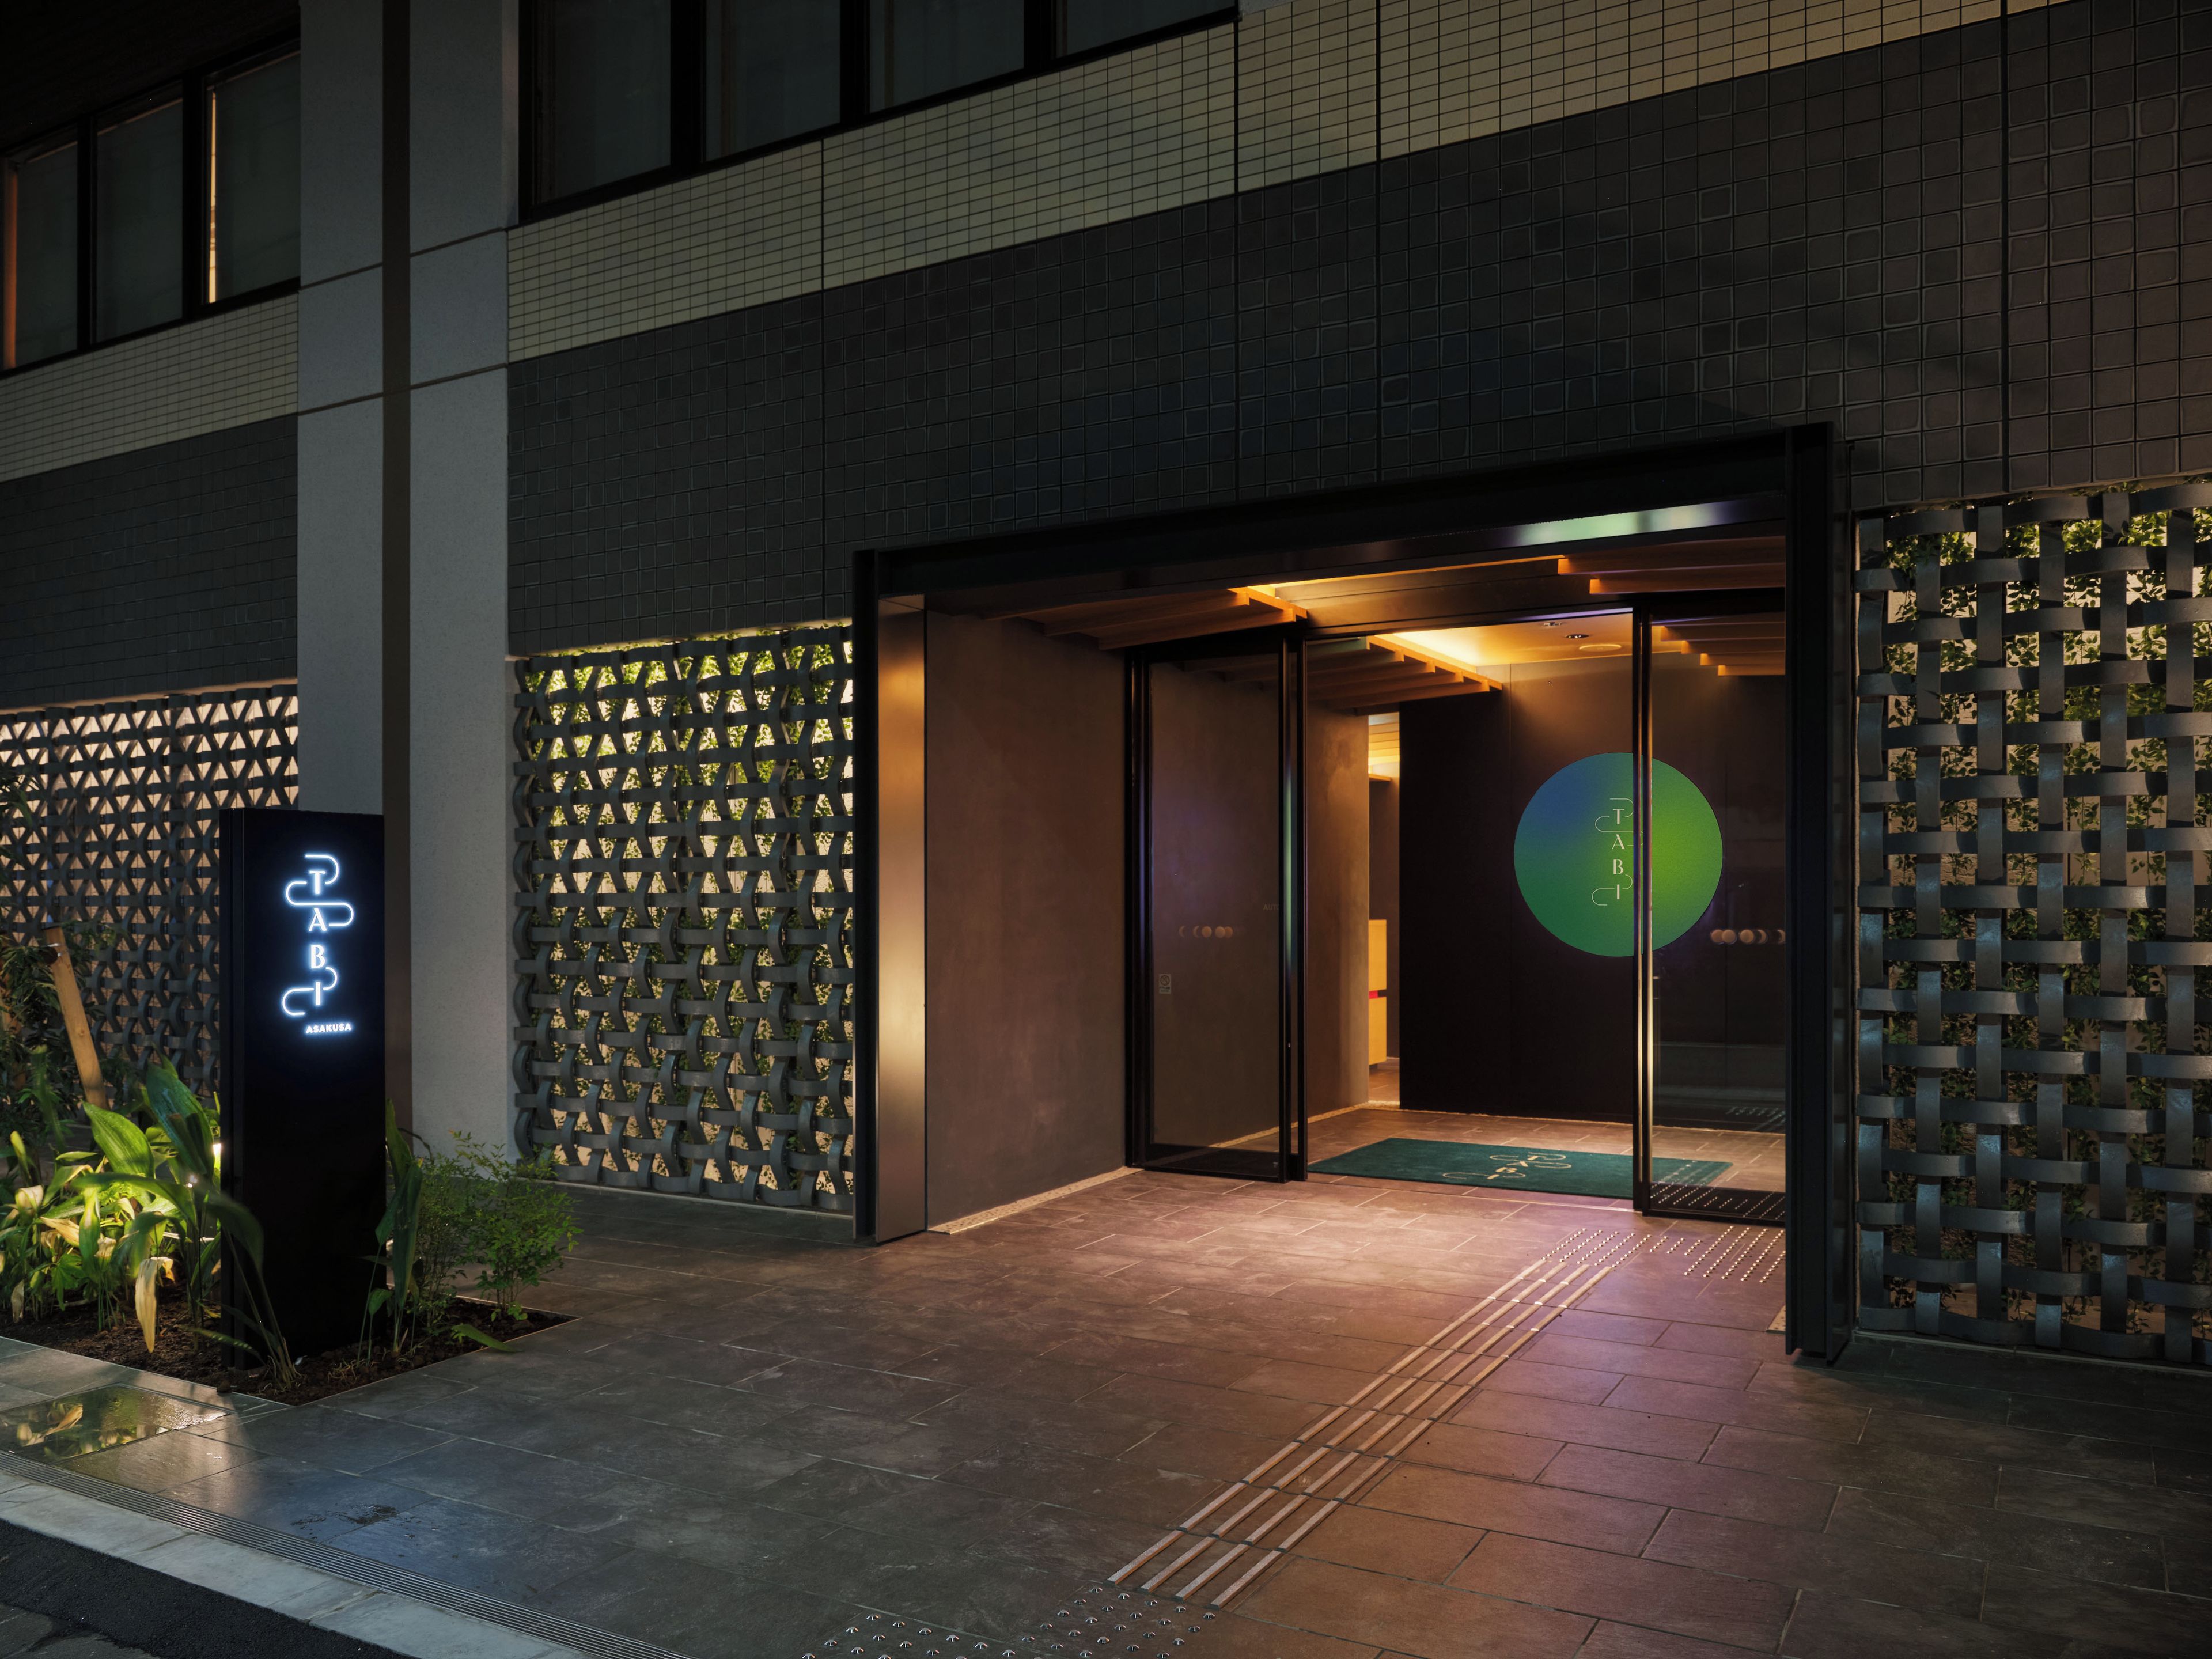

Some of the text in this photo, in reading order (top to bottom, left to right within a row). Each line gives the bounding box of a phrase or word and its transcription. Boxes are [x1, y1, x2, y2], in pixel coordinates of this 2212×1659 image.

[1612, 809, 1626, 900] TABI
[308, 870, 328, 1006] TABI
[306, 1022, 352, 1034] ASAKUSA
